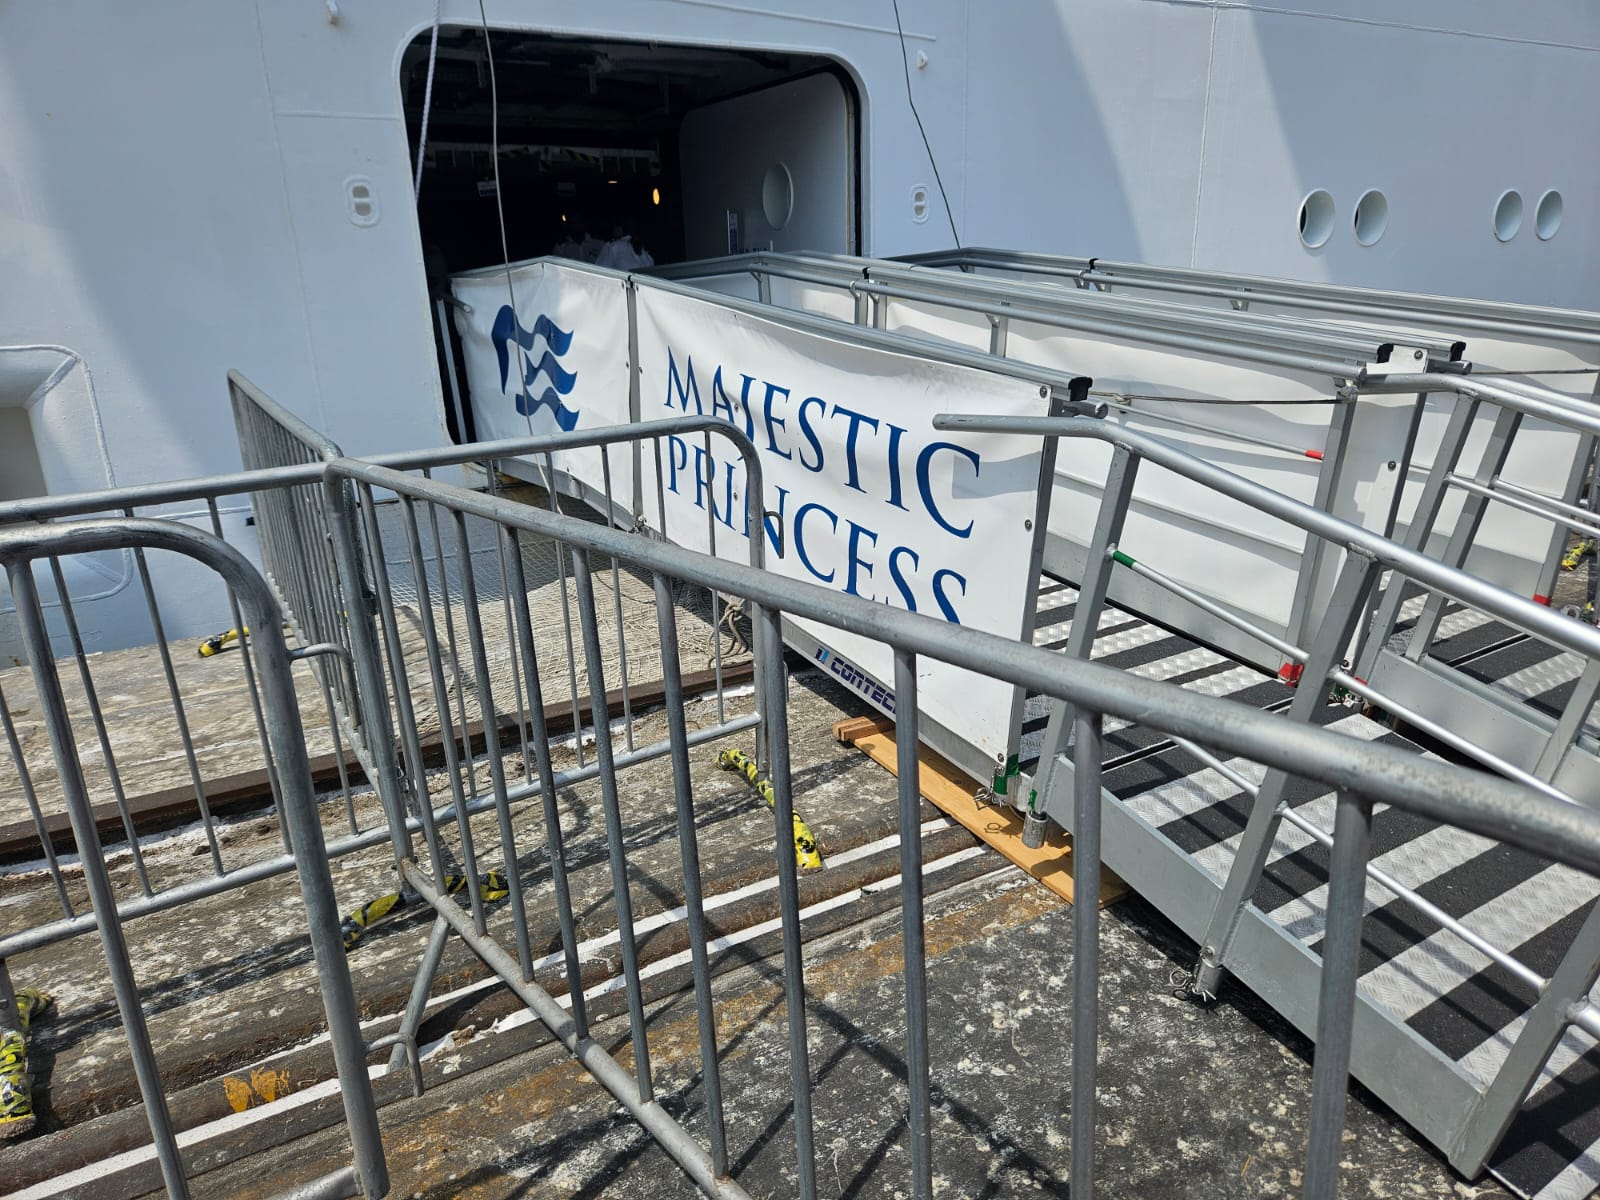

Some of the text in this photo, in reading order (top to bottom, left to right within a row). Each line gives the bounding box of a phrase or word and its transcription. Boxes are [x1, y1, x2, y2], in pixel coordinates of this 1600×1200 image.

[664, 345, 980, 538] MAJESTIC
[667, 434, 966, 625] PRINCESS
[830, 656, 897, 714] CONTEC
